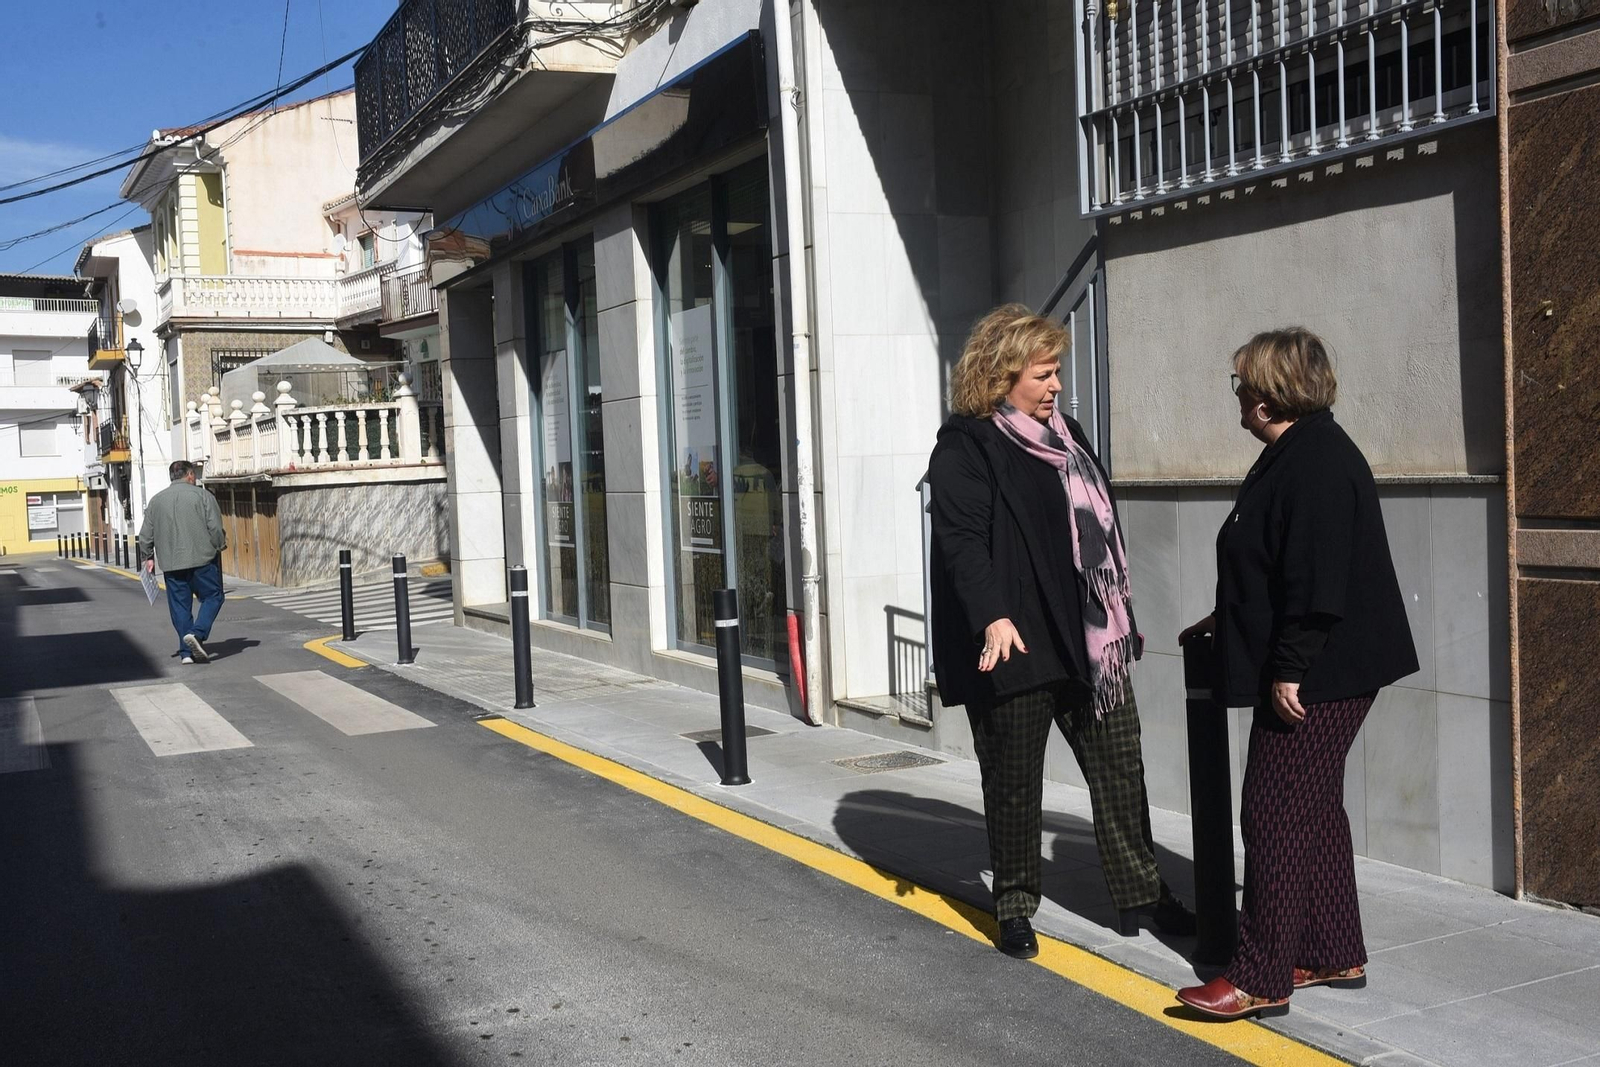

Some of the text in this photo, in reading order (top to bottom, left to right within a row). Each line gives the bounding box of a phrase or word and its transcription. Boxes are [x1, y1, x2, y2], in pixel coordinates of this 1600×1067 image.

[523, 167, 573, 218] CaixaBank
[552, 506, 569, 519] SIENTE
[687, 501, 714, 517] SIENTE
[690, 518, 712, 535] AGRO
